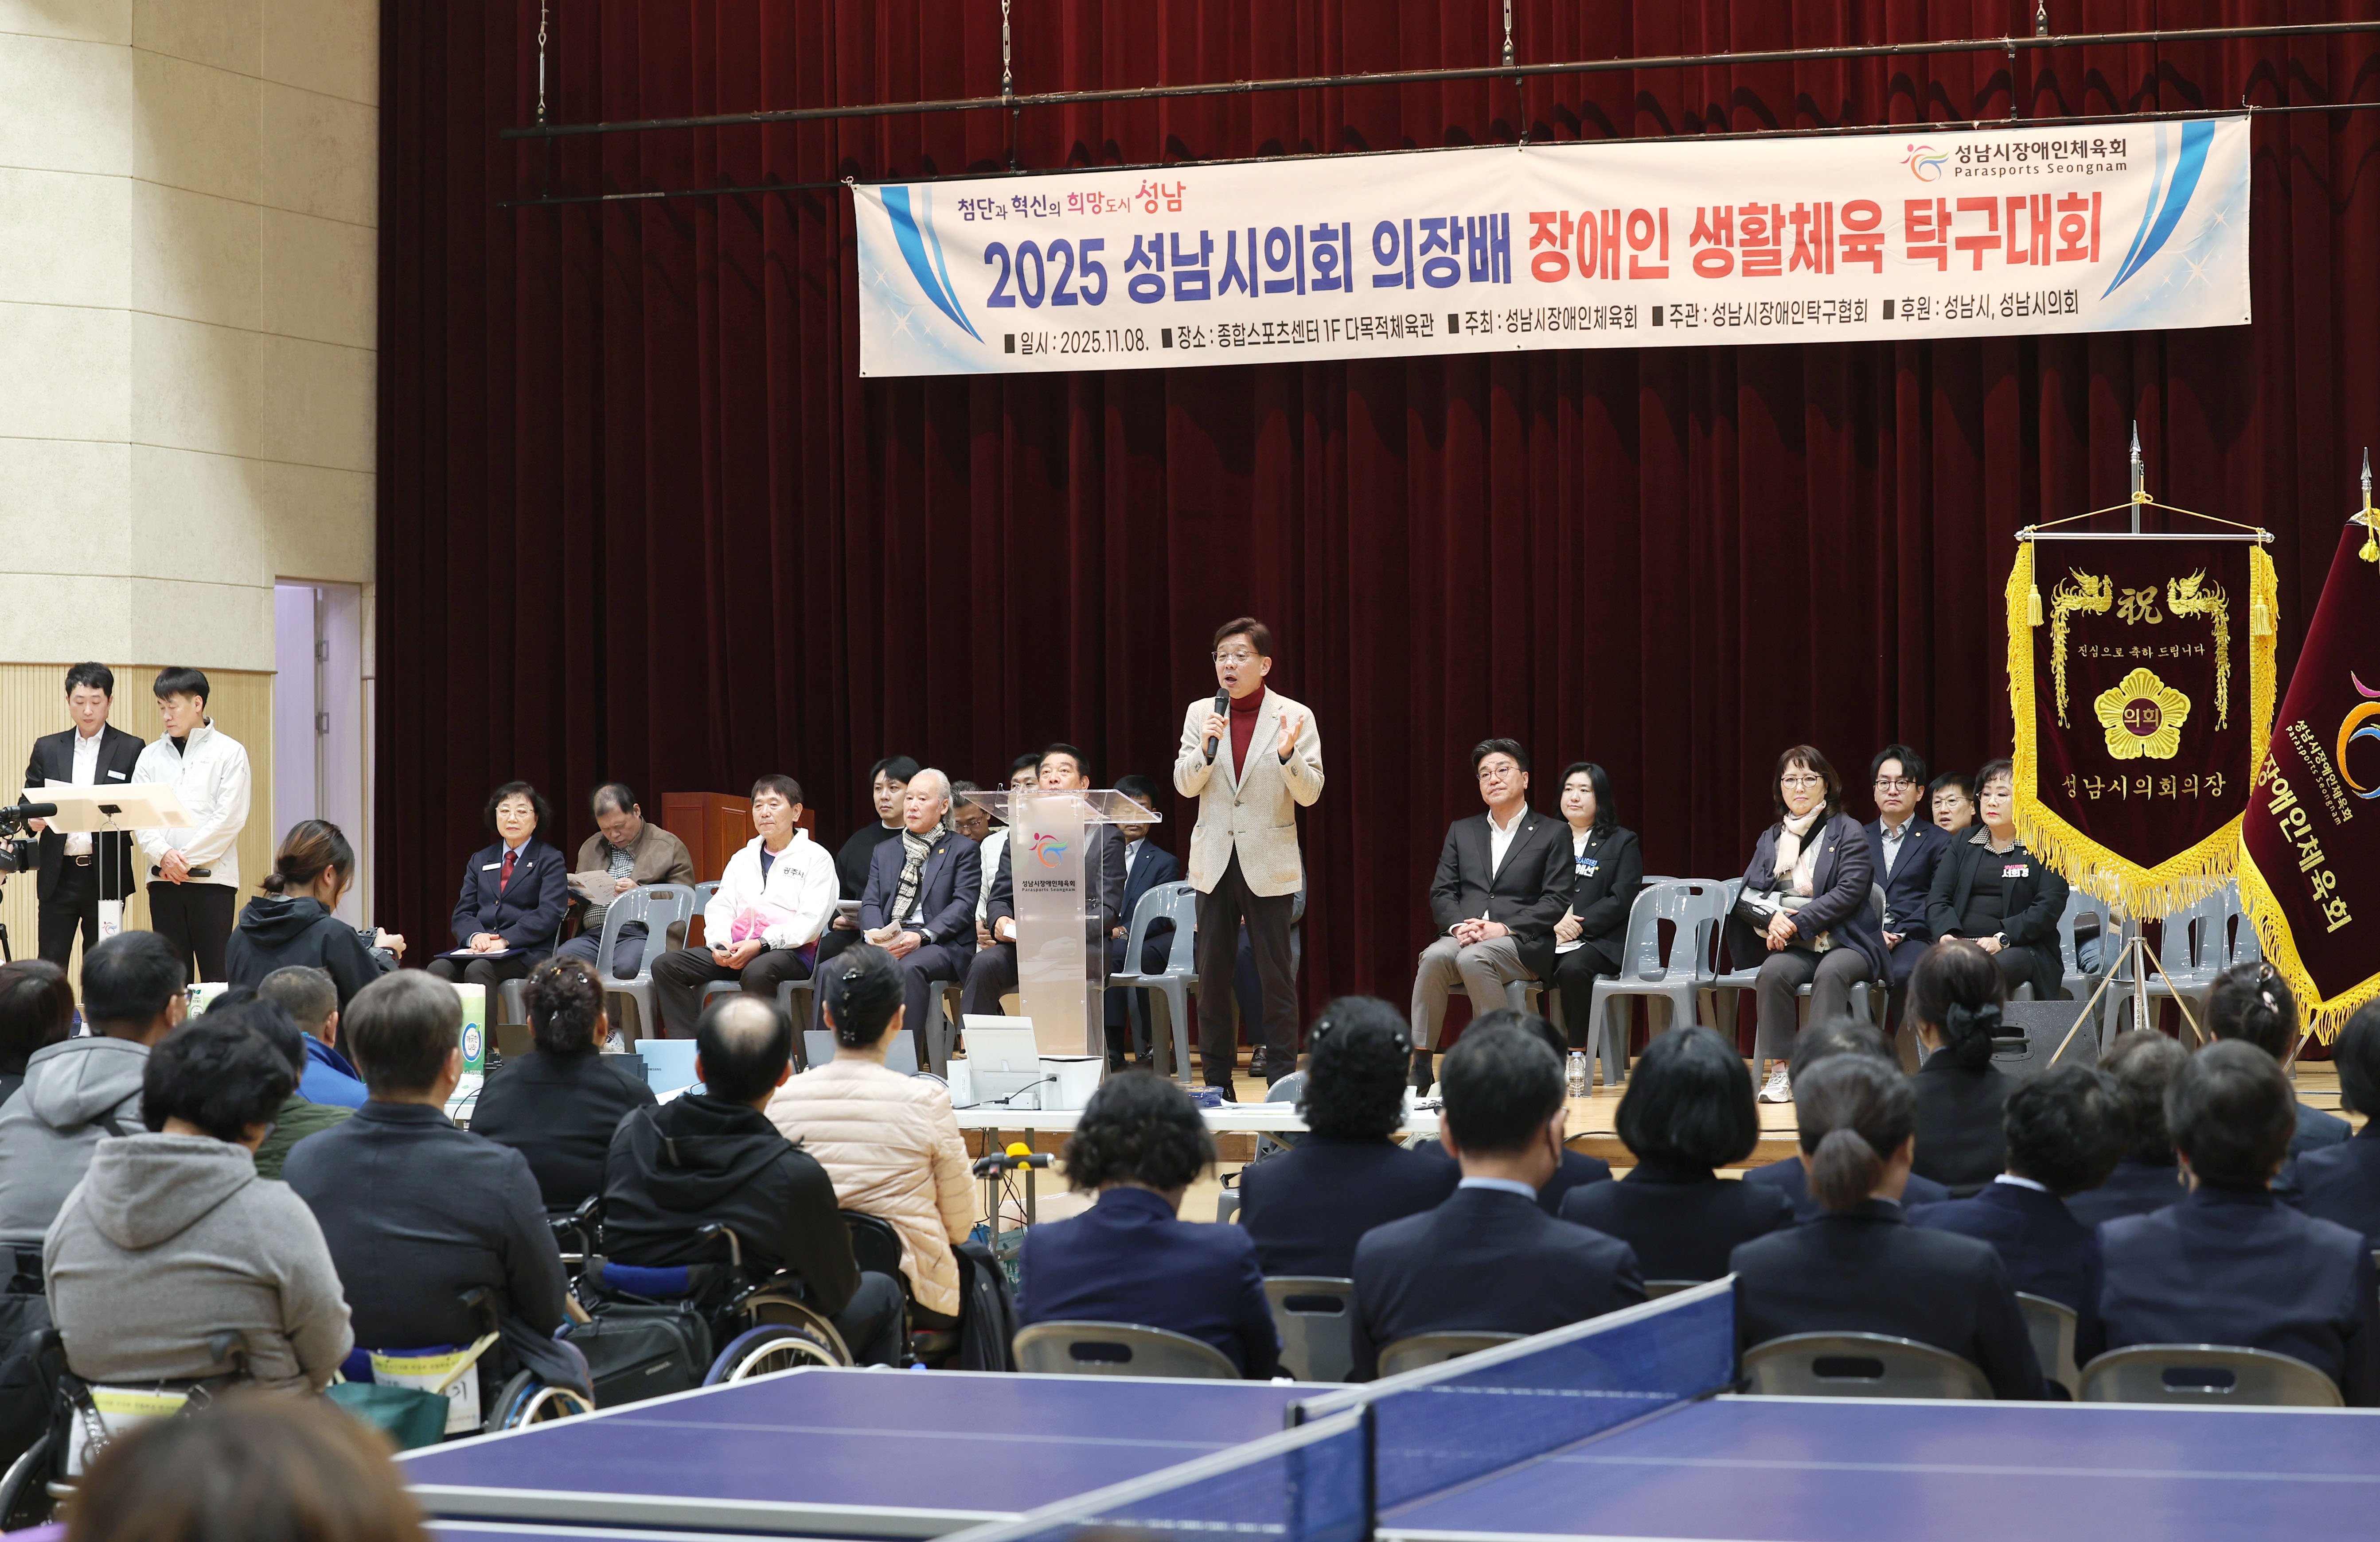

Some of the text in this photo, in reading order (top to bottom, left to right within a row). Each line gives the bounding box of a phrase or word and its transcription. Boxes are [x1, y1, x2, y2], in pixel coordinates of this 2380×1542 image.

[1955, 139, 2127, 164] 성남시장애인체육회
[1955, 162, 2127, 178] Parasports Seongnam
[958, 179, 1186, 221] 첨단과 혁신의 희망도시 성남
[984, 192, 2101, 308] 2025 성남시의회 의장배 장애인 생활체육 탁구대회
[1061, 328, 1148, 353] 2025.11.08.
[1218, 319, 1319, 347] 종합스포츠센터
[1323, 319, 1340, 342] 1F
[1346, 313, 1434, 341] 다목적체육관
[1506, 305, 1636, 333] 성남시장애인체육회
[1713, 299, 1867, 327] 성남시장애인탁구협회
[1945, 294, 1994, 320] 성남시,
[2000, 289, 2078, 317] 성남시의회
[2117, 586, 2162, 625] 祝
[2078, 643, 2204, 658] 진심으로 축하 드립니다
[2124, 708, 2160, 727] 의회
[2285, 725, 2341, 826] Parasports Seongnam
[2295, 720, 2353, 822] 성남시장애인체육회
[2062, 772, 2226, 800] 성남시의회의장
[2258, 753, 2353, 933] 장애인체육회
[784, 867, 804, 878] 광주시
[1575, 856, 1598, 867] 남시의원
[1575, 864, 1595, 877] 혜선
[2002, 868, 2029, 878] 서희경
[466, 1035, 478, 1043] 깨끗한
